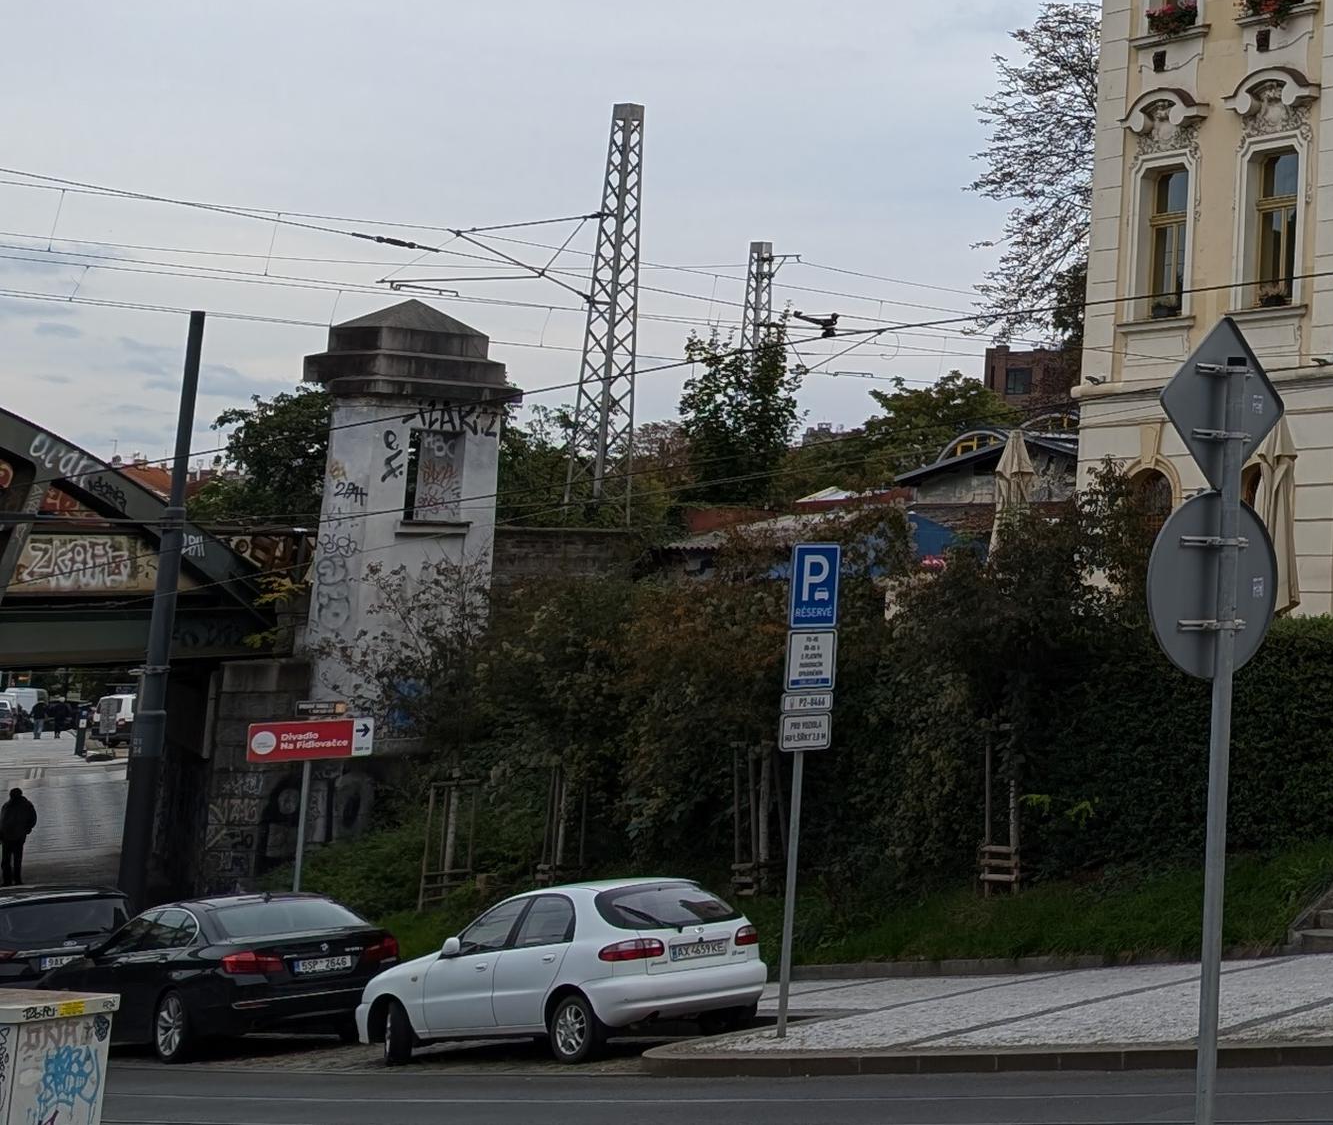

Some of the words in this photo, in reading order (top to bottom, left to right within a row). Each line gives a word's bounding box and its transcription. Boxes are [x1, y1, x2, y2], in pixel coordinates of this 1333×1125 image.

[802, 555, 830, 601] P
[795, 605, 833, 618] RÉSERVÉ
[280, 732, 319, 742] Divadlo
[280, 741, 294, 750] Na
